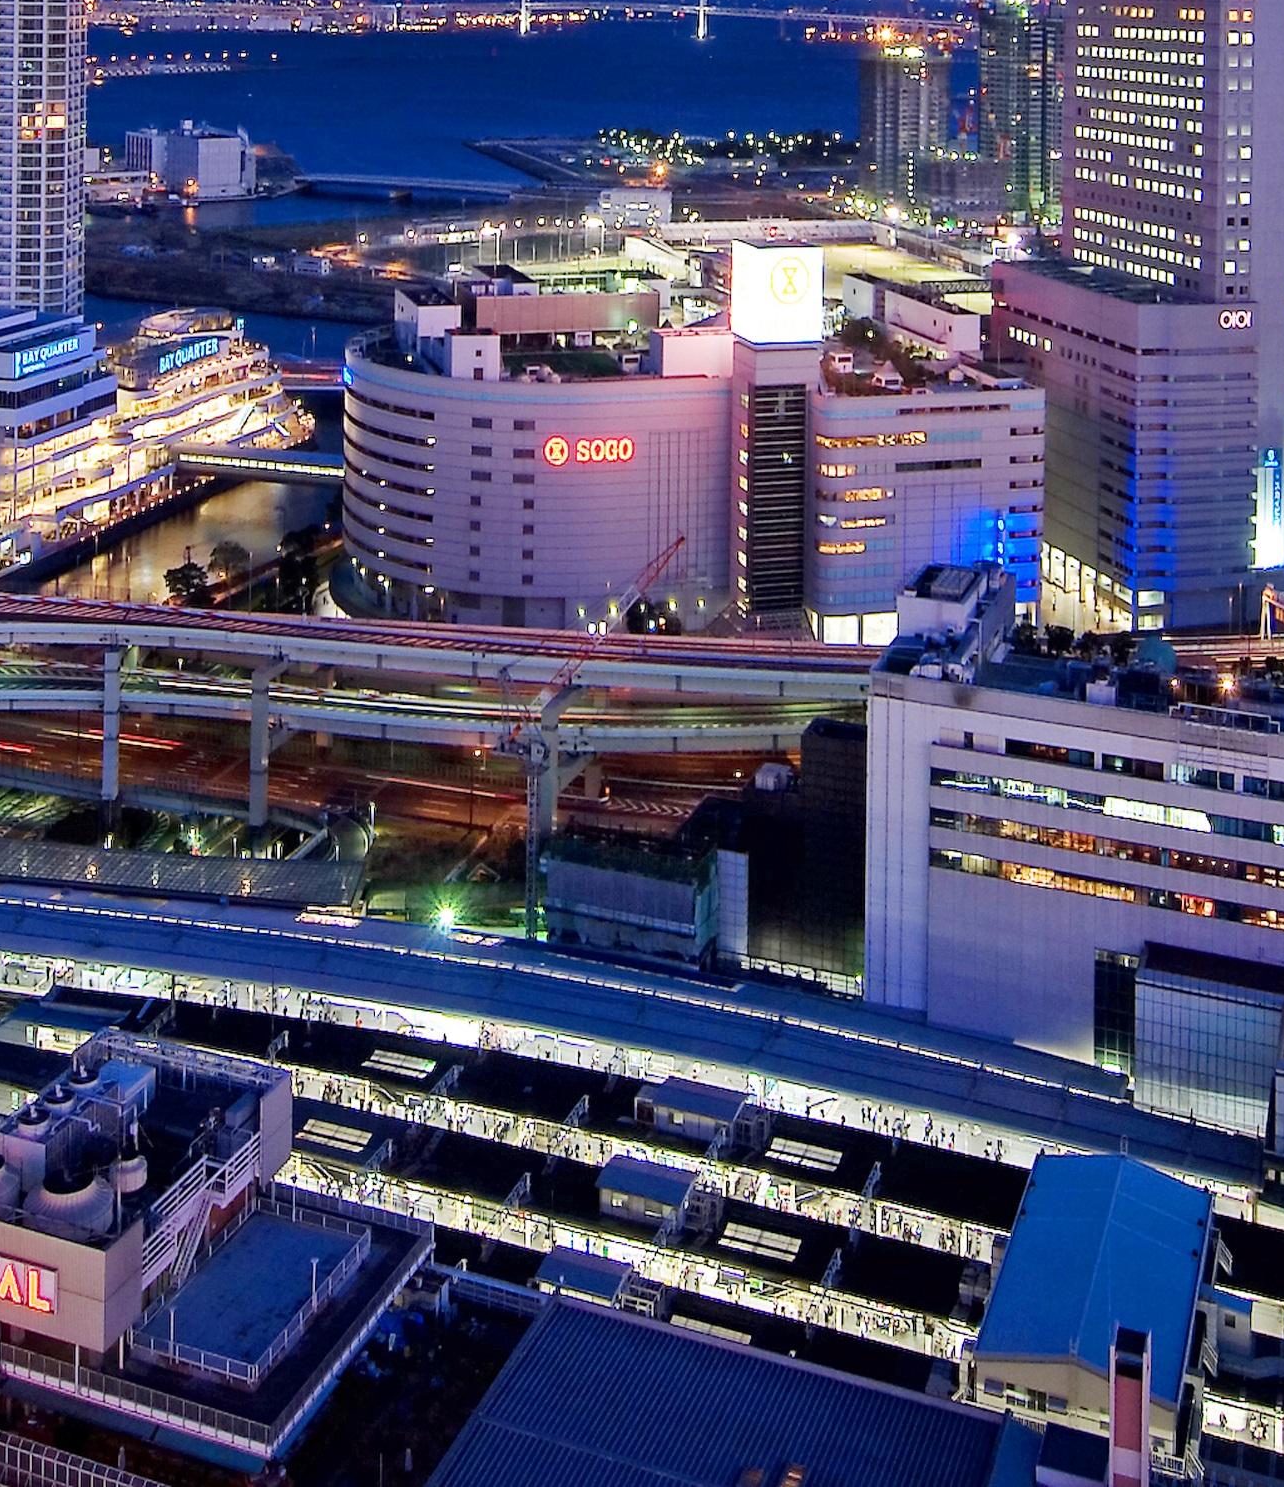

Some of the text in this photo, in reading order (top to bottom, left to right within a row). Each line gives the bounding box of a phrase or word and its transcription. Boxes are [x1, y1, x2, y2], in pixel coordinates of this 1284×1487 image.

[22, 338, 79, 365] BAY QUARTER
[158, 338, 219, 374] BAY QUARTER
[575, 438, 634, 463] SOGO
